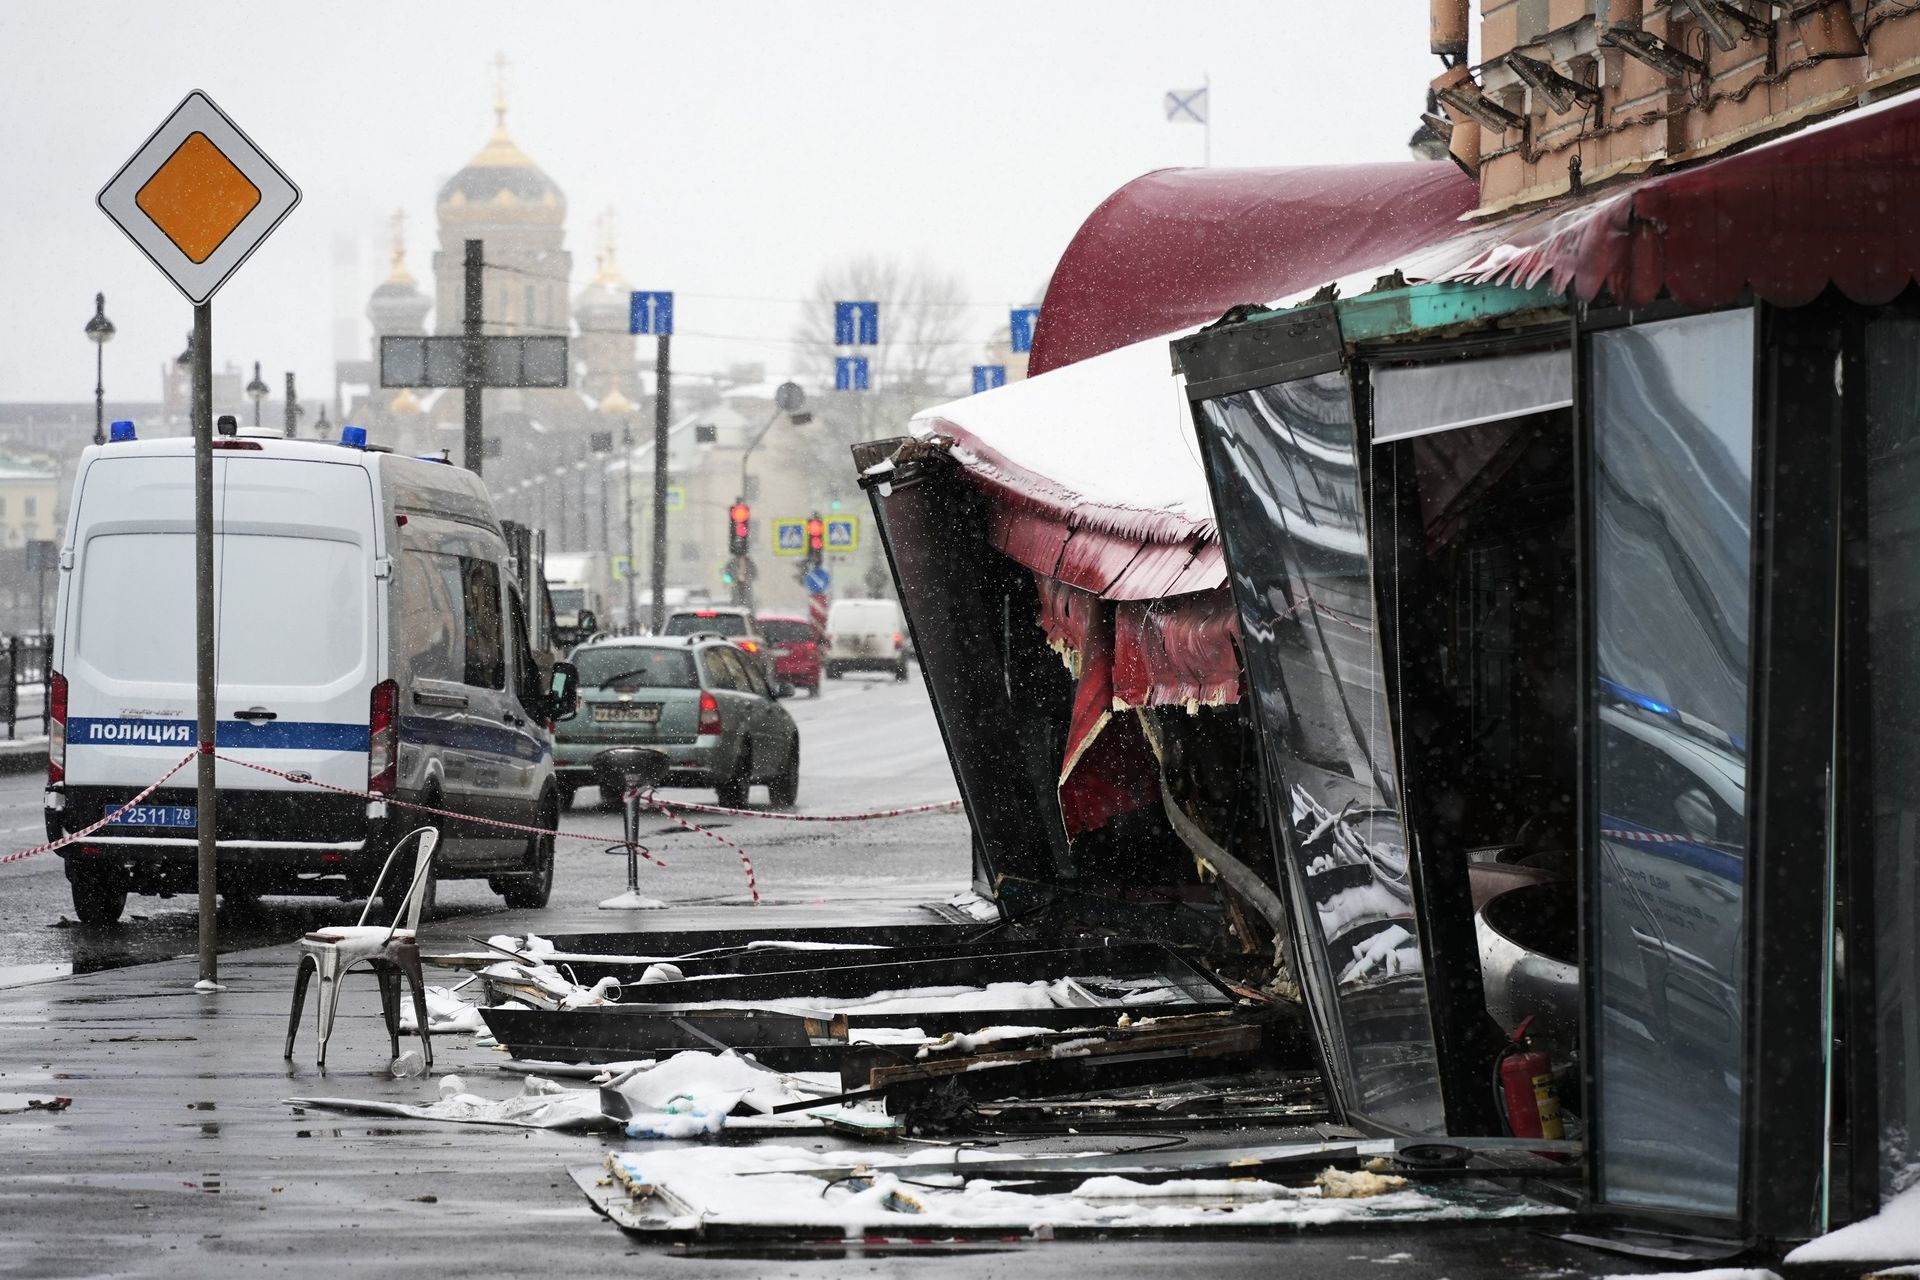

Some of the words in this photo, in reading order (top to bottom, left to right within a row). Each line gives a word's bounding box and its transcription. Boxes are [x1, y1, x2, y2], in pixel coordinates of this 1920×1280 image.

[90, 723, 190, 743] ПОЛИЦИЯ
[127, 808, 166, 824] 2511
[176, 808, 191, 820] 78
